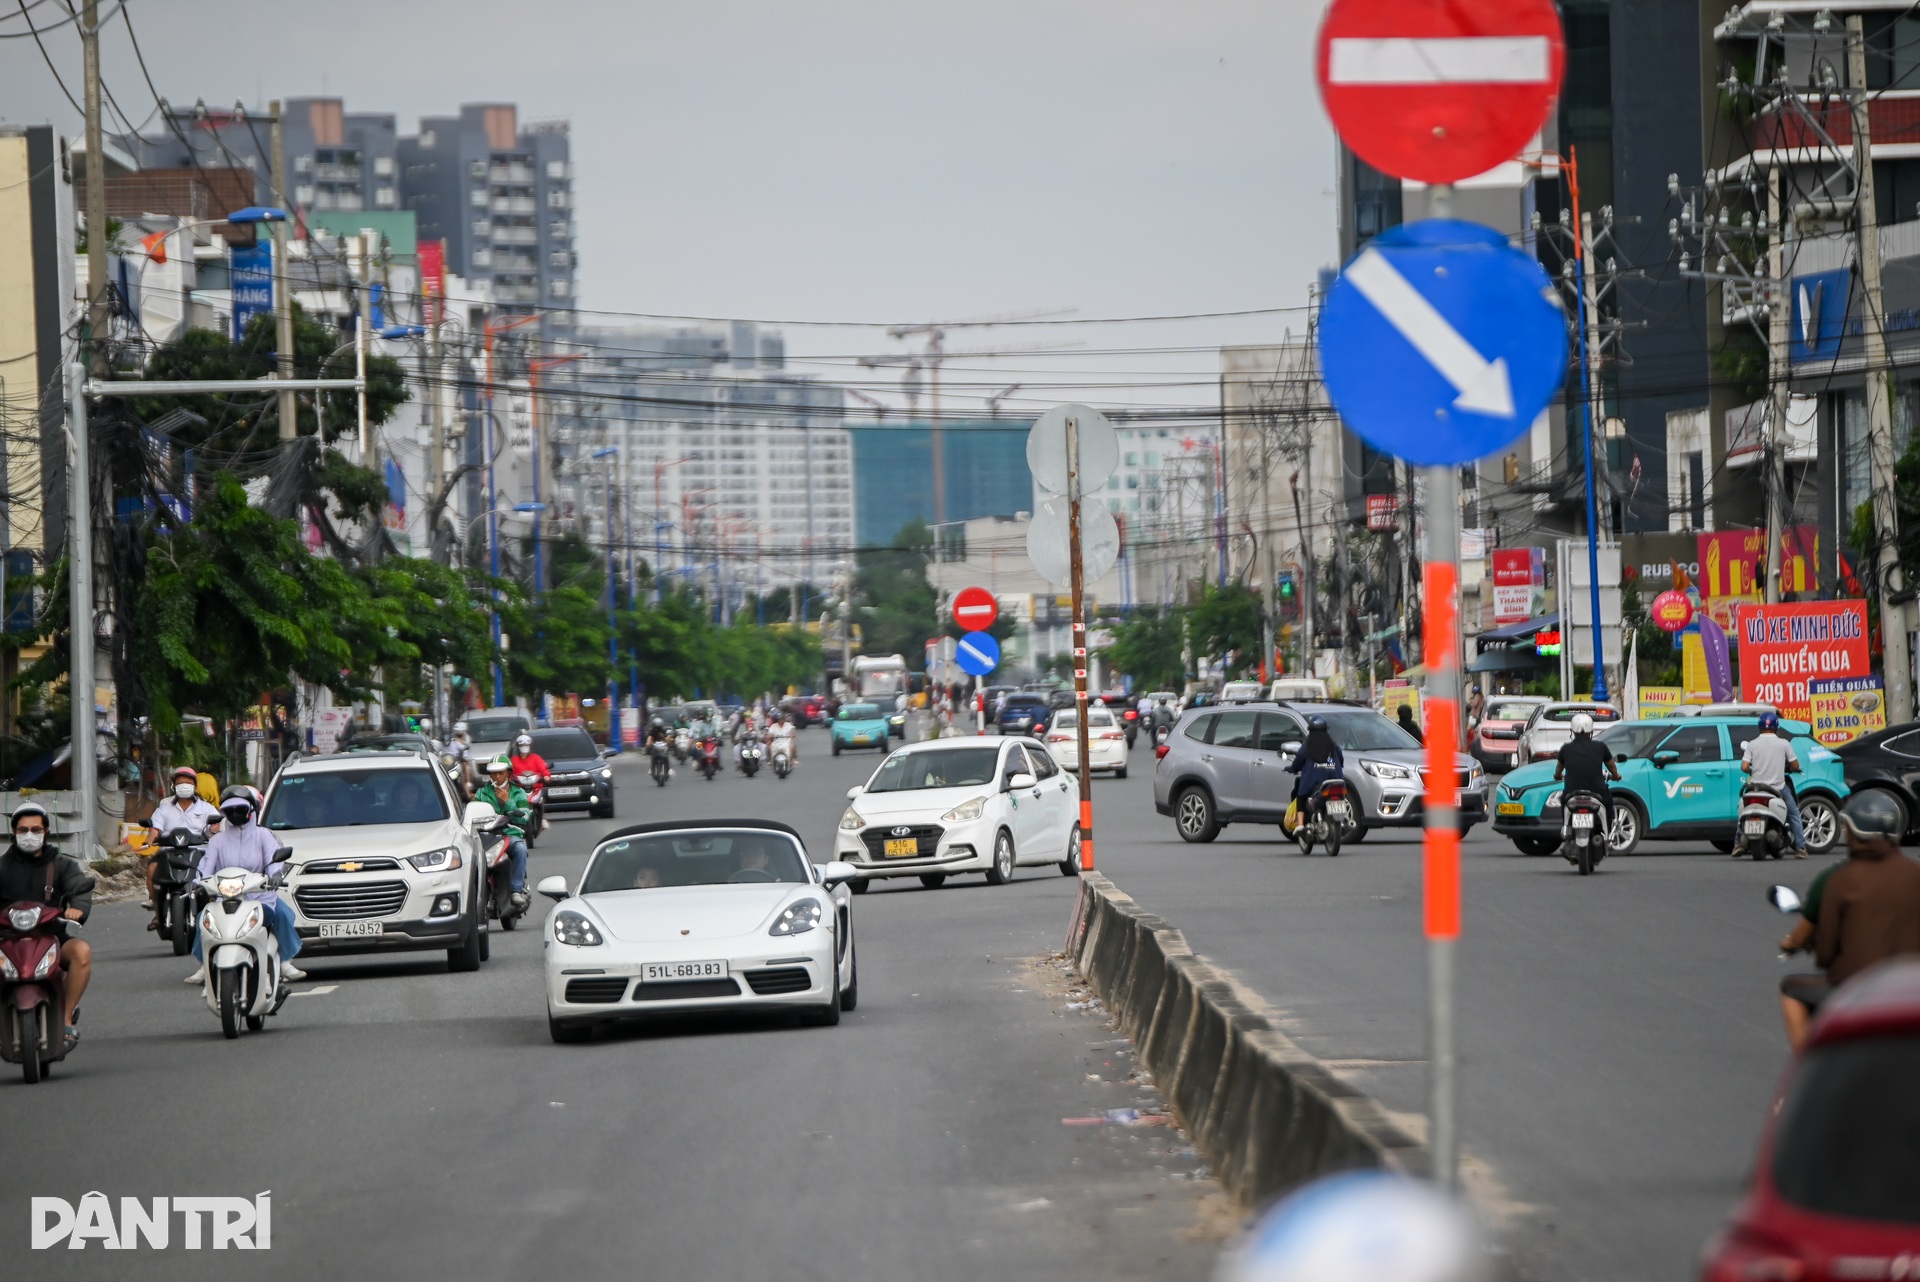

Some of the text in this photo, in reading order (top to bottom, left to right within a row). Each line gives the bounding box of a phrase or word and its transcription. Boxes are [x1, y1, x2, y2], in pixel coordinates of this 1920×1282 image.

[233, 264, 270, 280] NGÂN
[233, 286, 270, 302] HÀNG
[1499, 596, 1528, 604] THANH
[1746, 609, 1765, 643] VỎ
[1768, 616, 1788, 643] XE
[1790, 614, 1829, 642] MINH
[1831, 608, 1861, 639] ĐỨC
[1760, 644, 1851, 674] CHUYỂN QUA
[1755, 682, 1784, 704] 209
[1846, 678, 1876, 692] QUÁN
[1815, 693, 1848, 712] PHỞ
[1816, 713, 1883, 729] BÒ KHO 45K
[1821, 731, 1848, 742] CƠM
[893, 840, 908, 848] 51G
[321, 922, 381, 937] 51F-449.52
[649, 963, 721, 978] 51L-683.83
